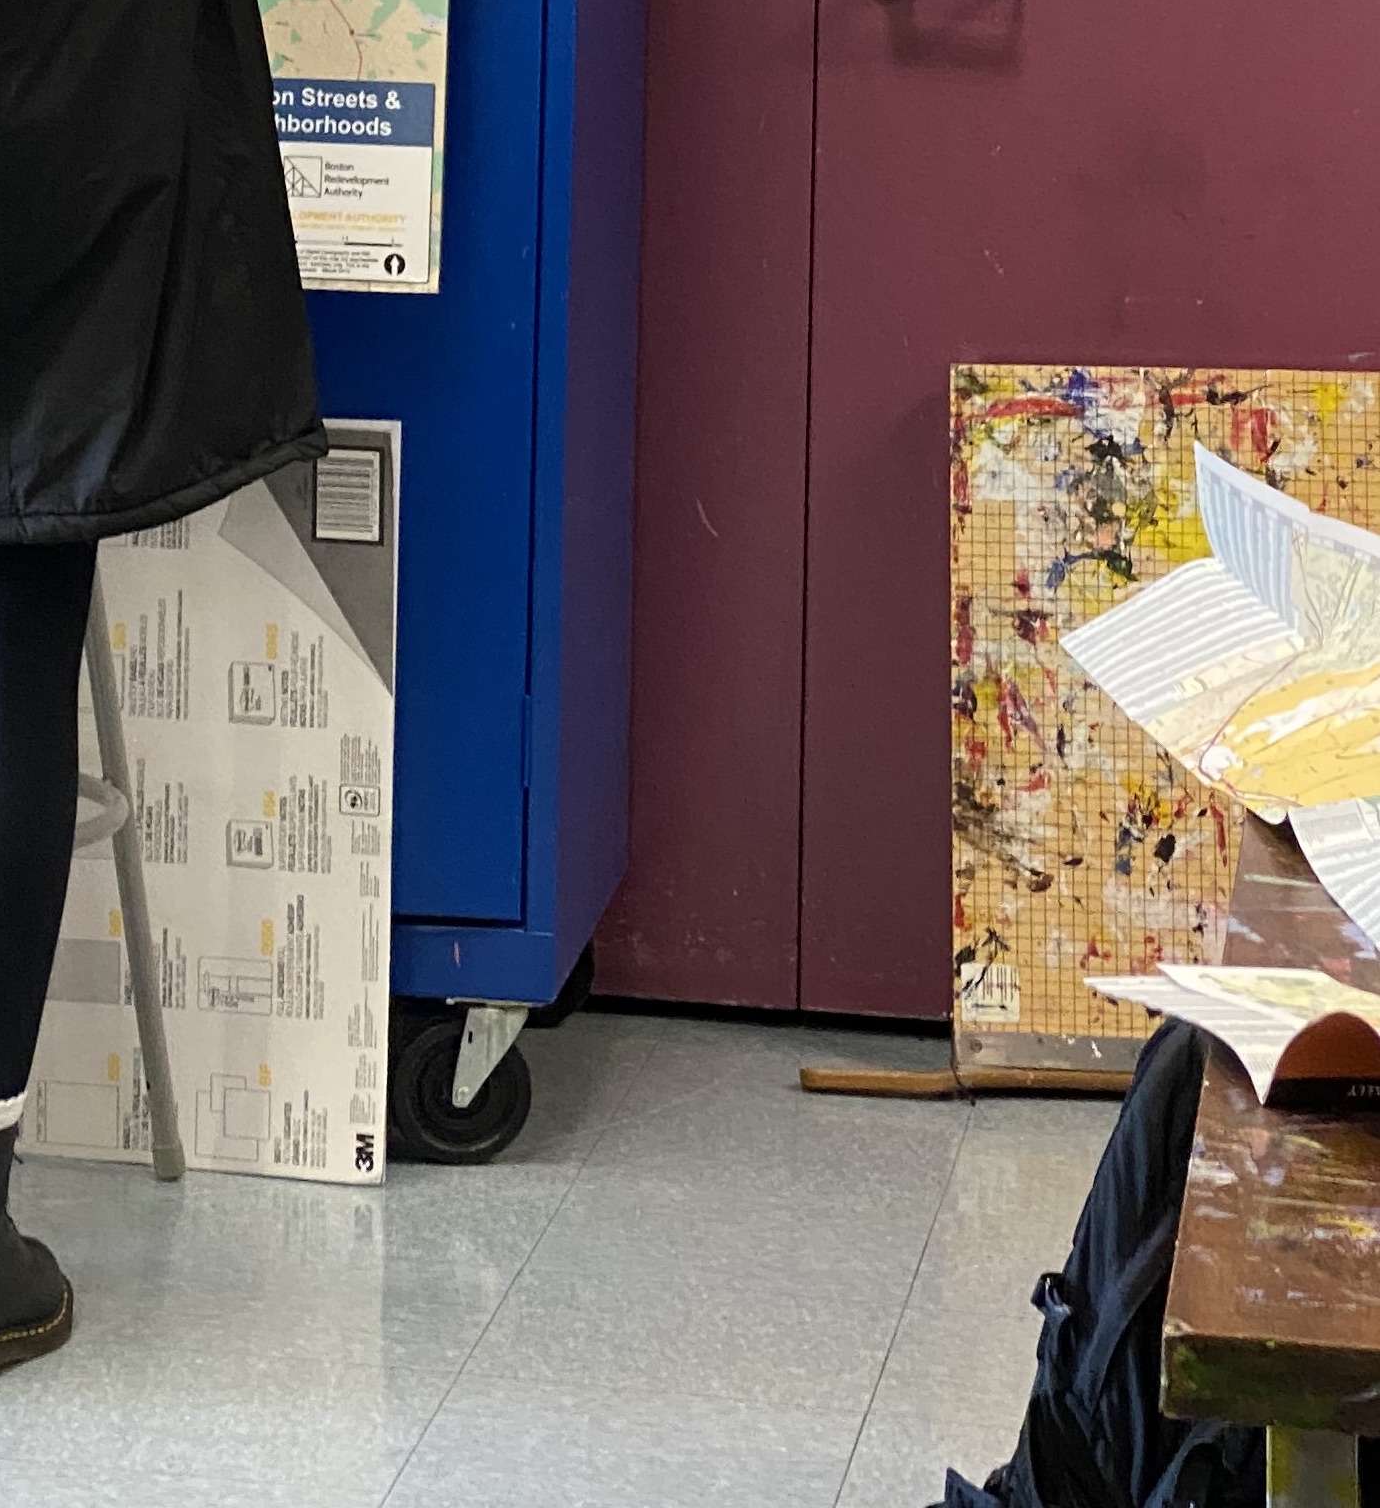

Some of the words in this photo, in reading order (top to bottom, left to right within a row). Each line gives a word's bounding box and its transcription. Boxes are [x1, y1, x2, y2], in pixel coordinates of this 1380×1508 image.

[301, 87, 378, 110] Streets
[385, 90, 401, 110] &
[324, 160, 355, 171] Boston
[324, 174, 390, 188] Redevelopment
[324, 187, 363, 200] Authority
[355, 1133, 374, 1172] 3M
